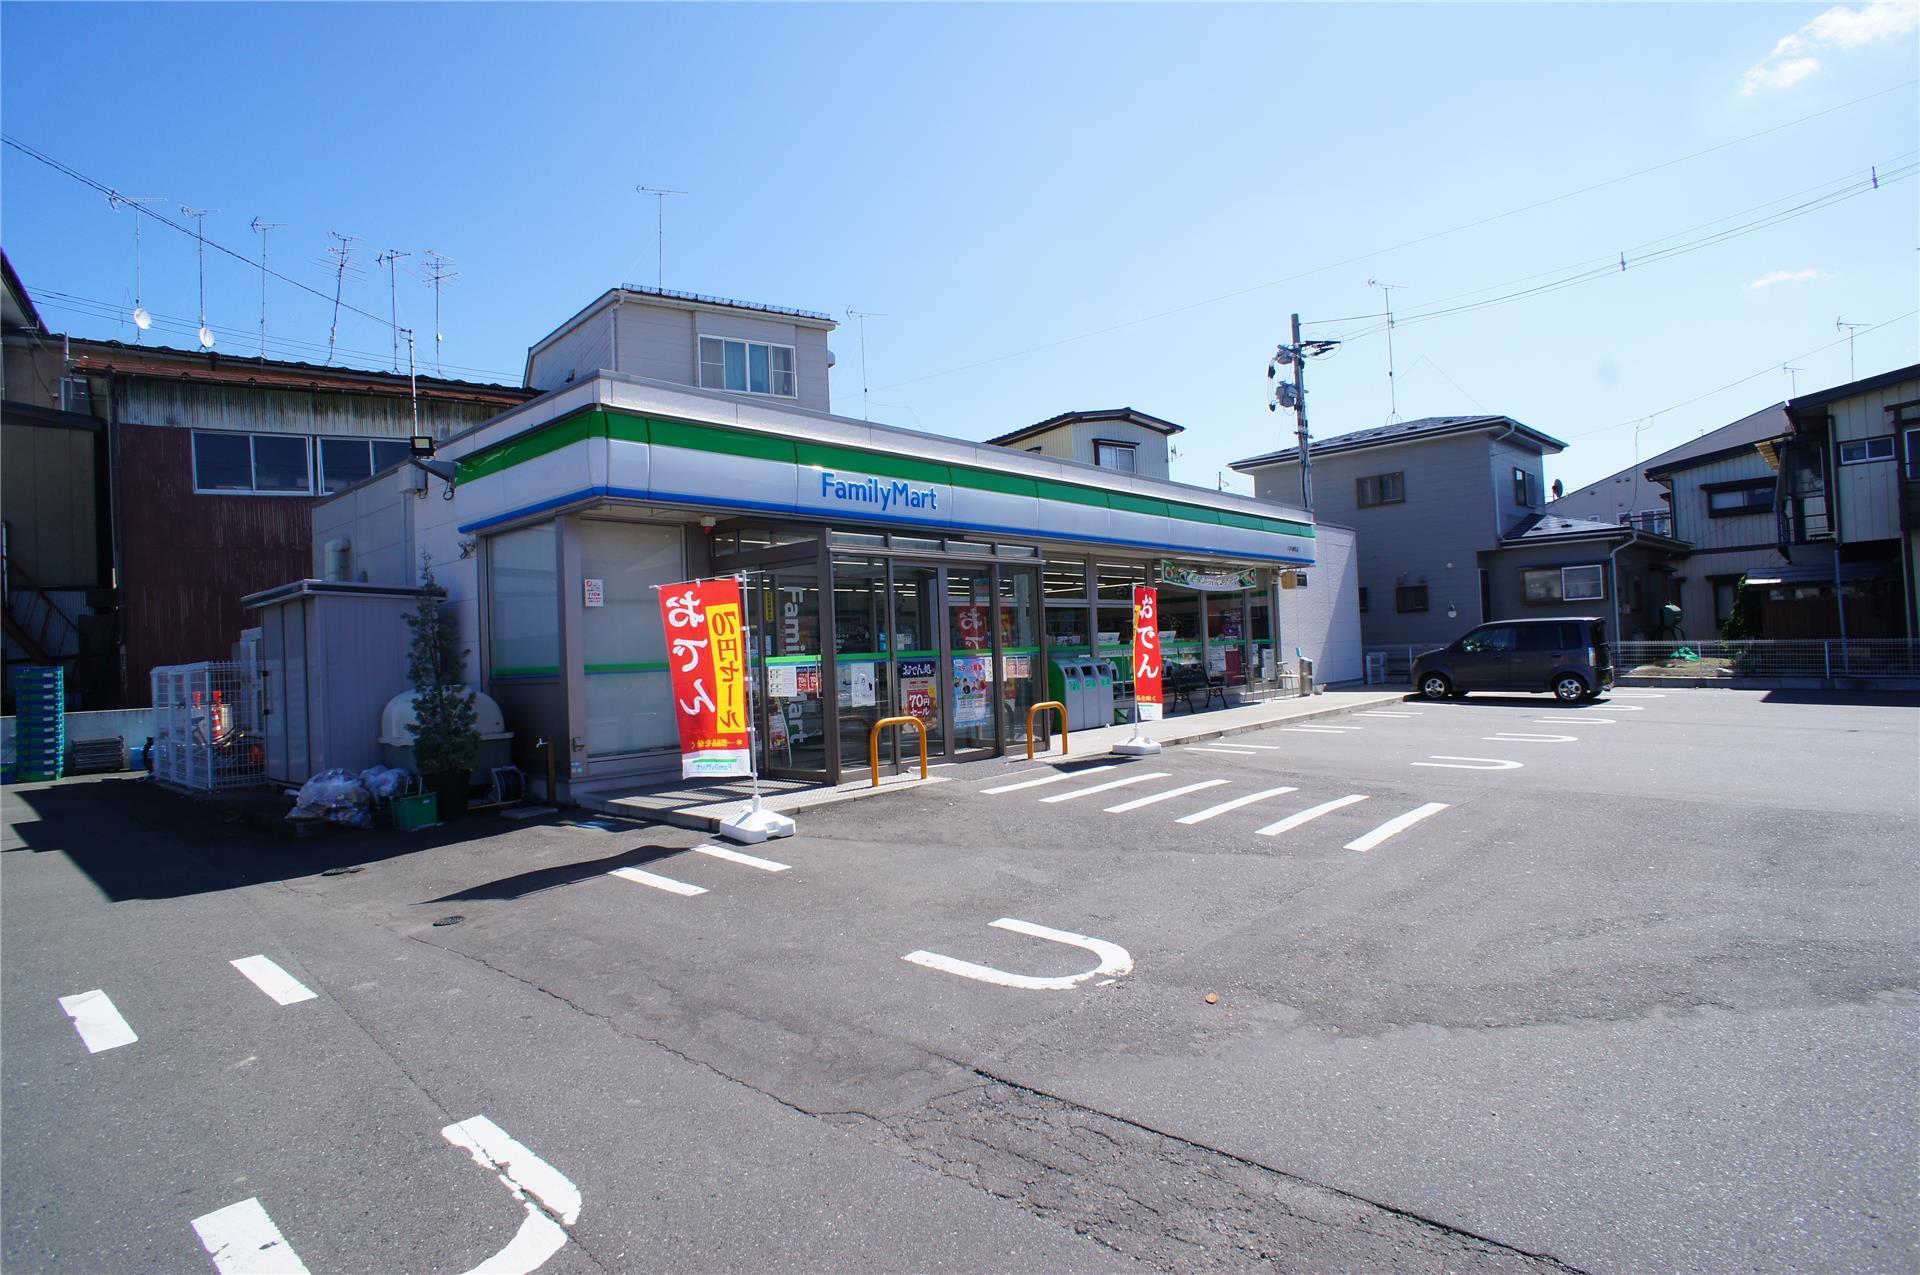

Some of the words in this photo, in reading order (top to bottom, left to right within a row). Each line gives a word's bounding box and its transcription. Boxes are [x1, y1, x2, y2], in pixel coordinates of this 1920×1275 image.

[822, 472, 937, 511] FamilyMart
[1137, 594, 1159, 678] おでん
[909, 693, 930, 708] 70円
[910, 707, 930, 717] セール
